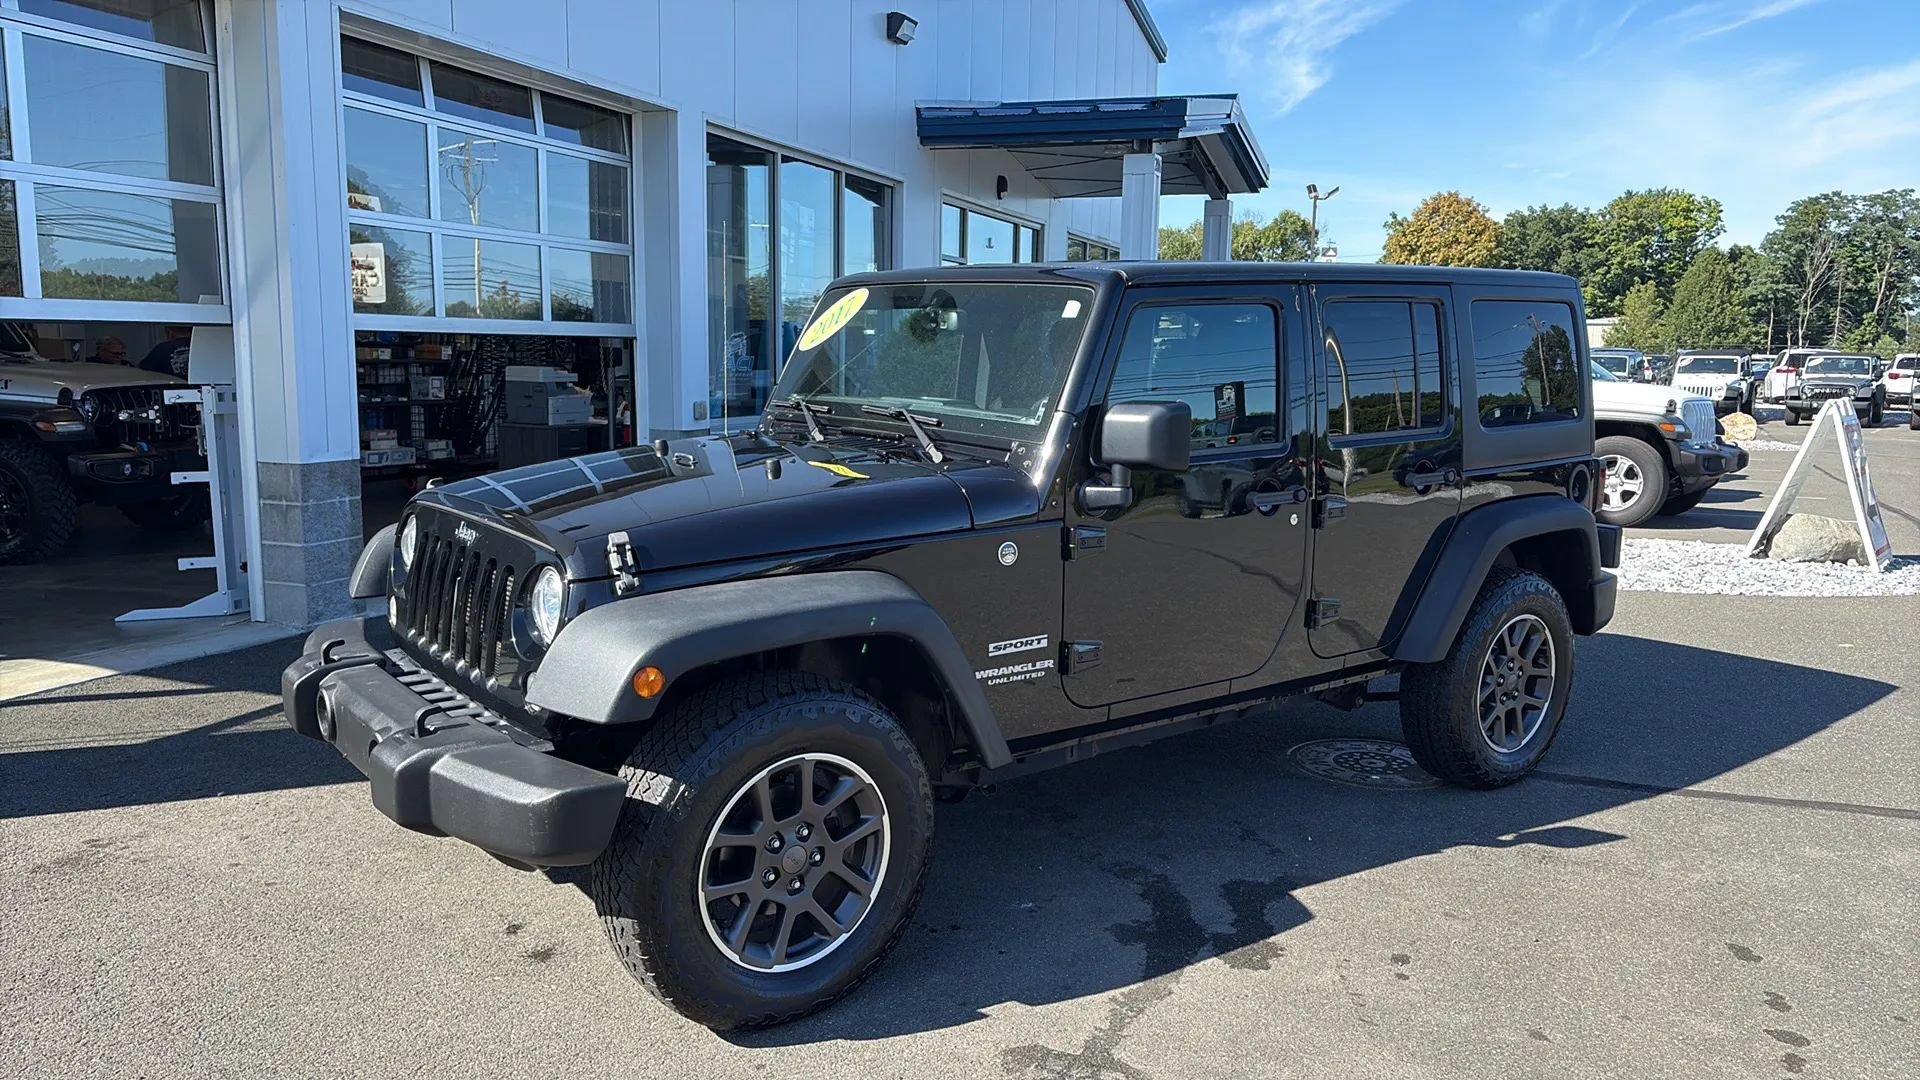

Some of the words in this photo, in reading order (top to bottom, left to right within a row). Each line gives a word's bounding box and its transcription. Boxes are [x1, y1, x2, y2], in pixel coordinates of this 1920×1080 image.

[808, 295, 857, 344] 2017
[991, 637, 1045, 653] SPORT
[975, 659, 1054, 680] WRANGLER
[988, 671, 1045, 686] UNLIMITED
